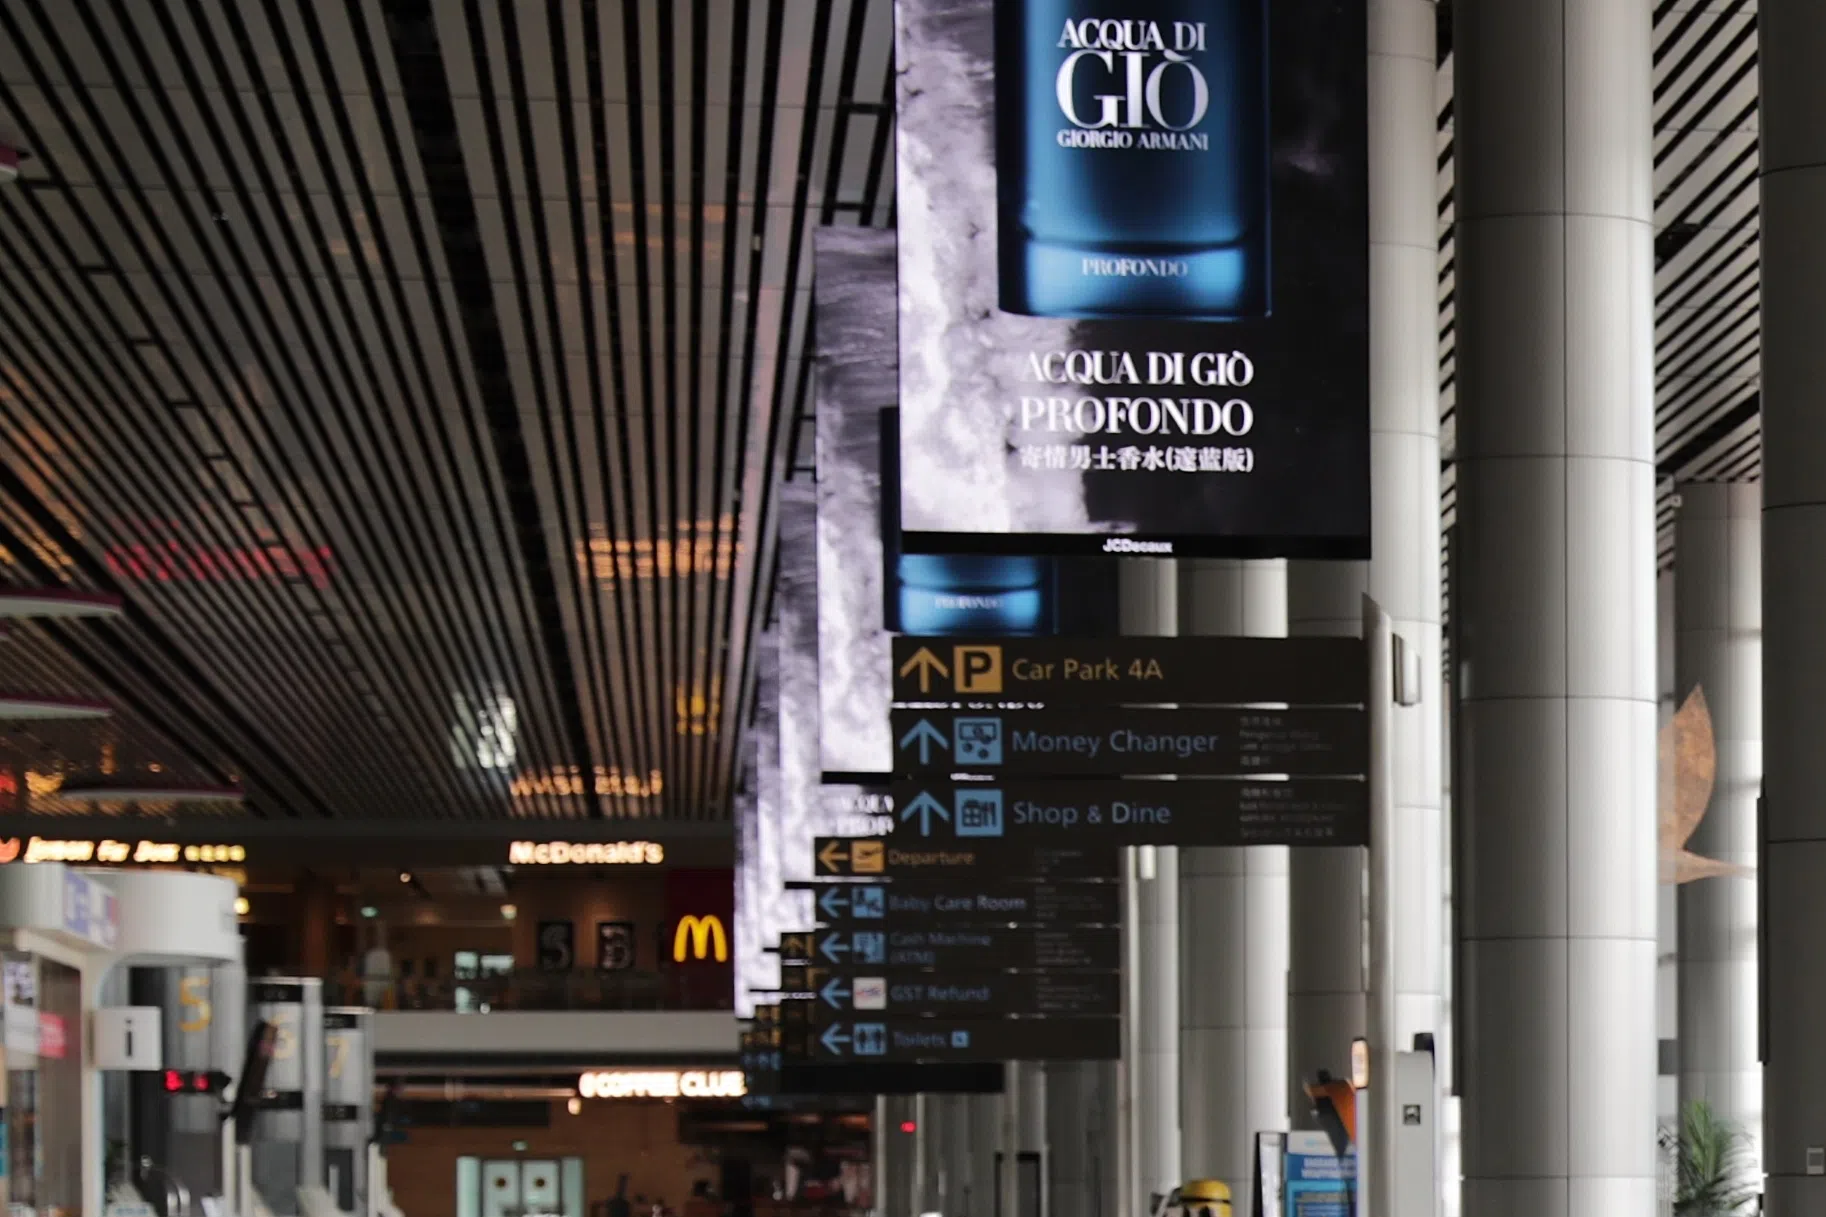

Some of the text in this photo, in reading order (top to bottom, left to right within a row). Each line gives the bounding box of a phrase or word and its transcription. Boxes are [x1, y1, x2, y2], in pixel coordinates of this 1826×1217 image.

[1057, 18, 1206, 52] ACQUA DI
[1056, 48, 1209, 132] GIÒ
[1057, 130, 1209, 151] GIORGIO ARMANI
[1081, 257, 1188, 278] PROFONDO
[1021, 350, 1254, 387] ACQUA DI GIÒ
[1020, 397, 1253, 436] PROFONDO
[1103, 538, 1172, 554] JCDecaux
[1012, 658, 1054, 681] Car
[1064, 658, 1120, 681] Park
[1127, 658, 1163, 680] 4A
[1012, 729, 1218, 760] Money Changer
[1013, 801, 1171, 830] Shop & Dine
[509, 840, 664, 865] McDonald's
[888, 849, 976, 869] Departure
[934, 894, 972, 911] Care
[976, 894, 1028, 911] Room
[928, 932, 992, 947] Machine
[890, 984, 992, 1001] GST Refund
[893, 1030, 946, 1048] Toilets
